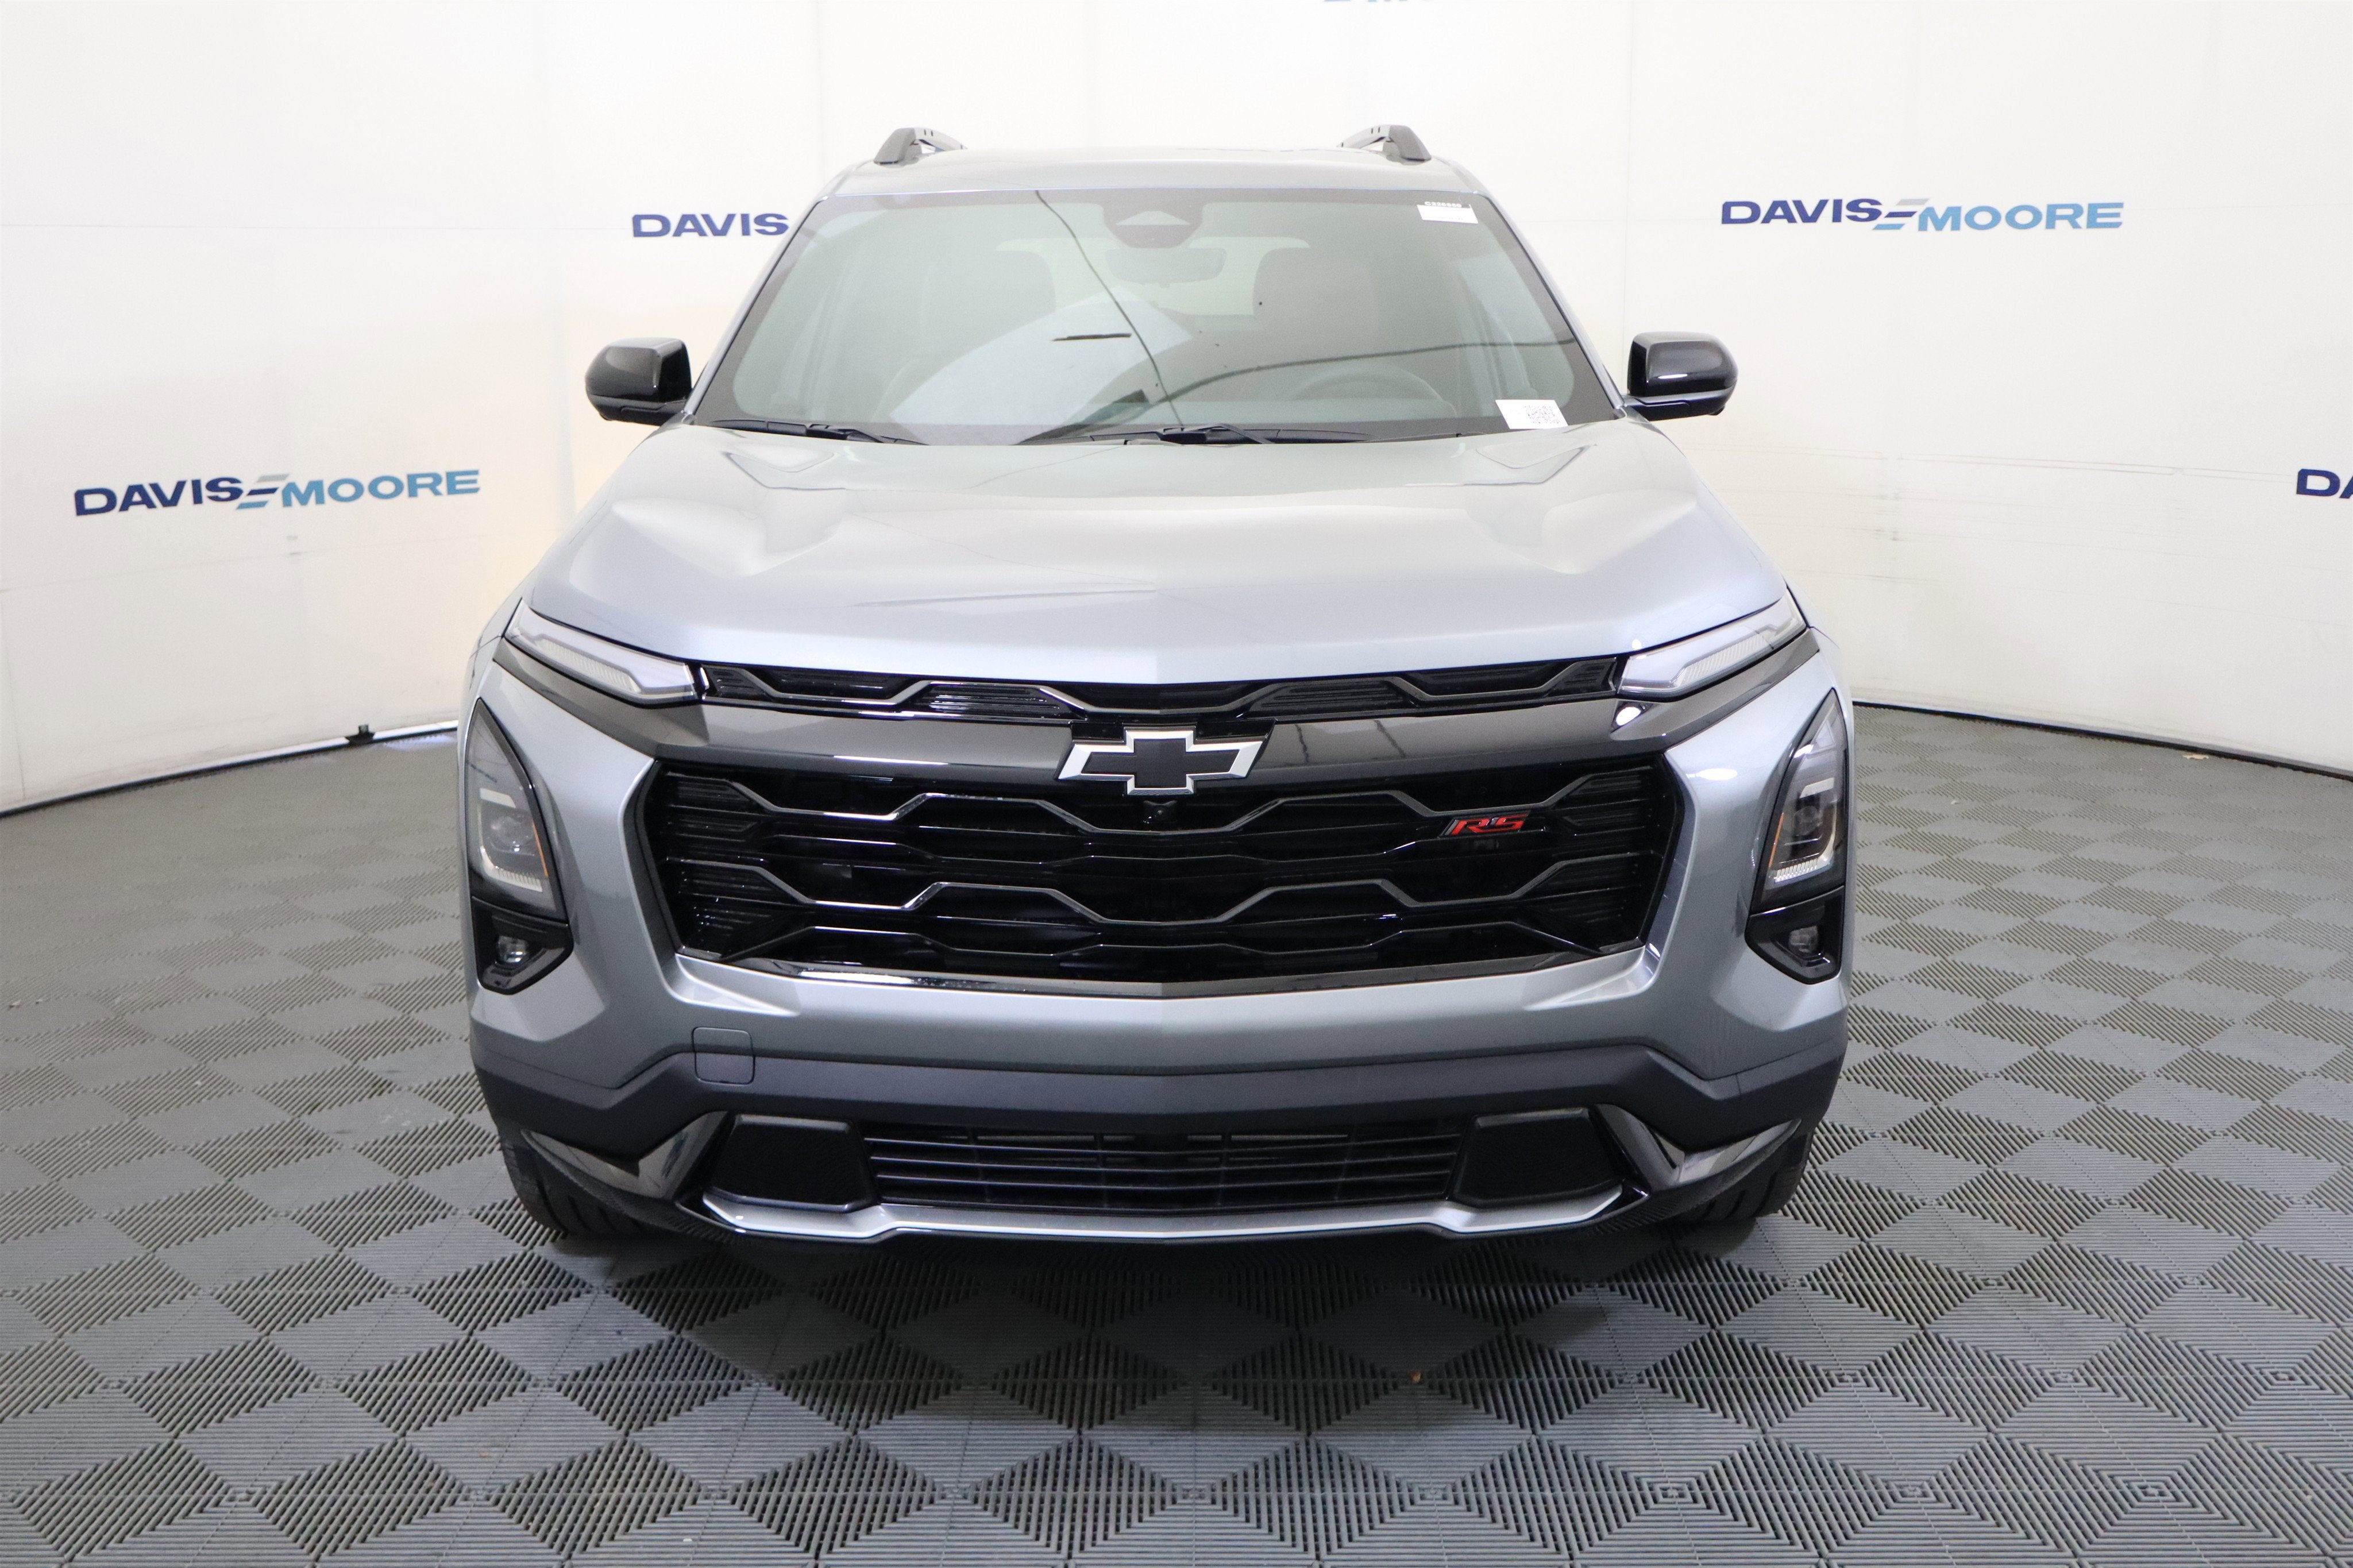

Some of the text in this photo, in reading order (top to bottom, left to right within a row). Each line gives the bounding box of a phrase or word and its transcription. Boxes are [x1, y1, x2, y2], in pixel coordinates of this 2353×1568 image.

[632, 213, 789, 237] DAVIS
[1722, 198, 2124, 231] DAVIS MOORE
[74, 470, 480, 516] DAVIS MOORE
[1445, 813, 1529, 836] RS
